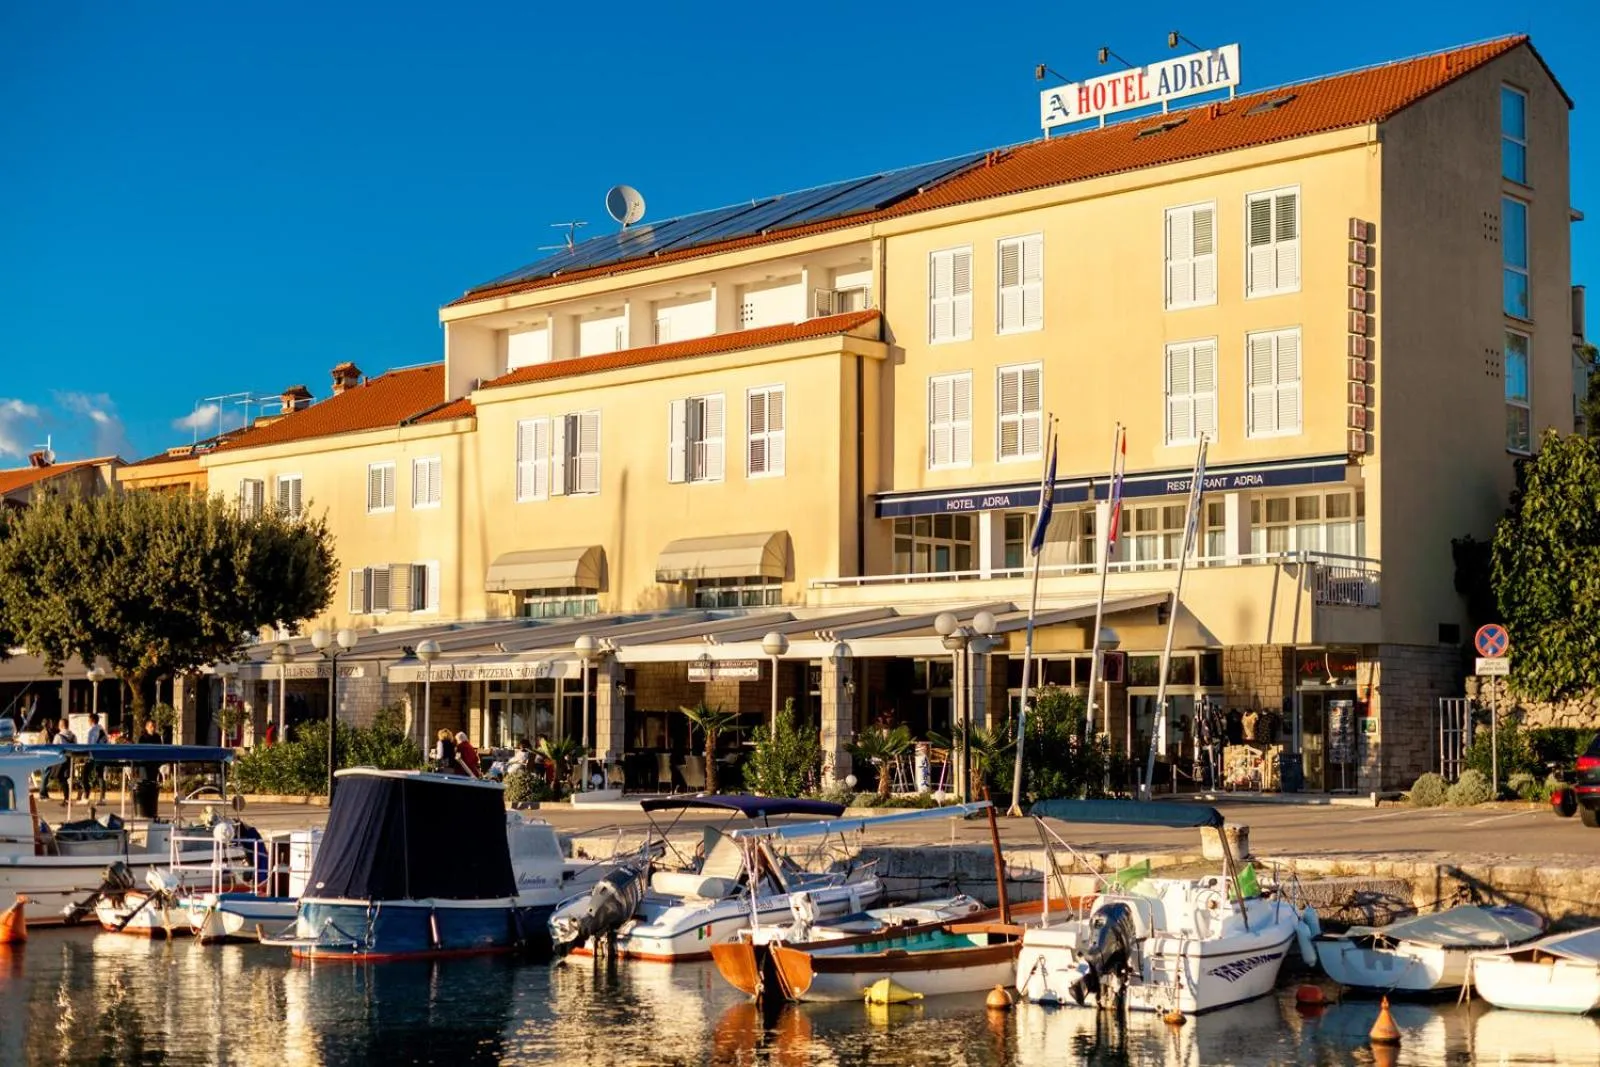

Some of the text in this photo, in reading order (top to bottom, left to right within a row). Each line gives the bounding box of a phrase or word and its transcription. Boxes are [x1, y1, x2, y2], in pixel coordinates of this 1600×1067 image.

[1077, 72, 1150, 115] HOTEL
[1157, 53, 1230, 96] ADRIA
[1233, 474, 1264, 486] ADRIA
[946, 495, 1010, 510] HOTEL ADRIA
[478, 667, 514, 679] PIZZERIA
